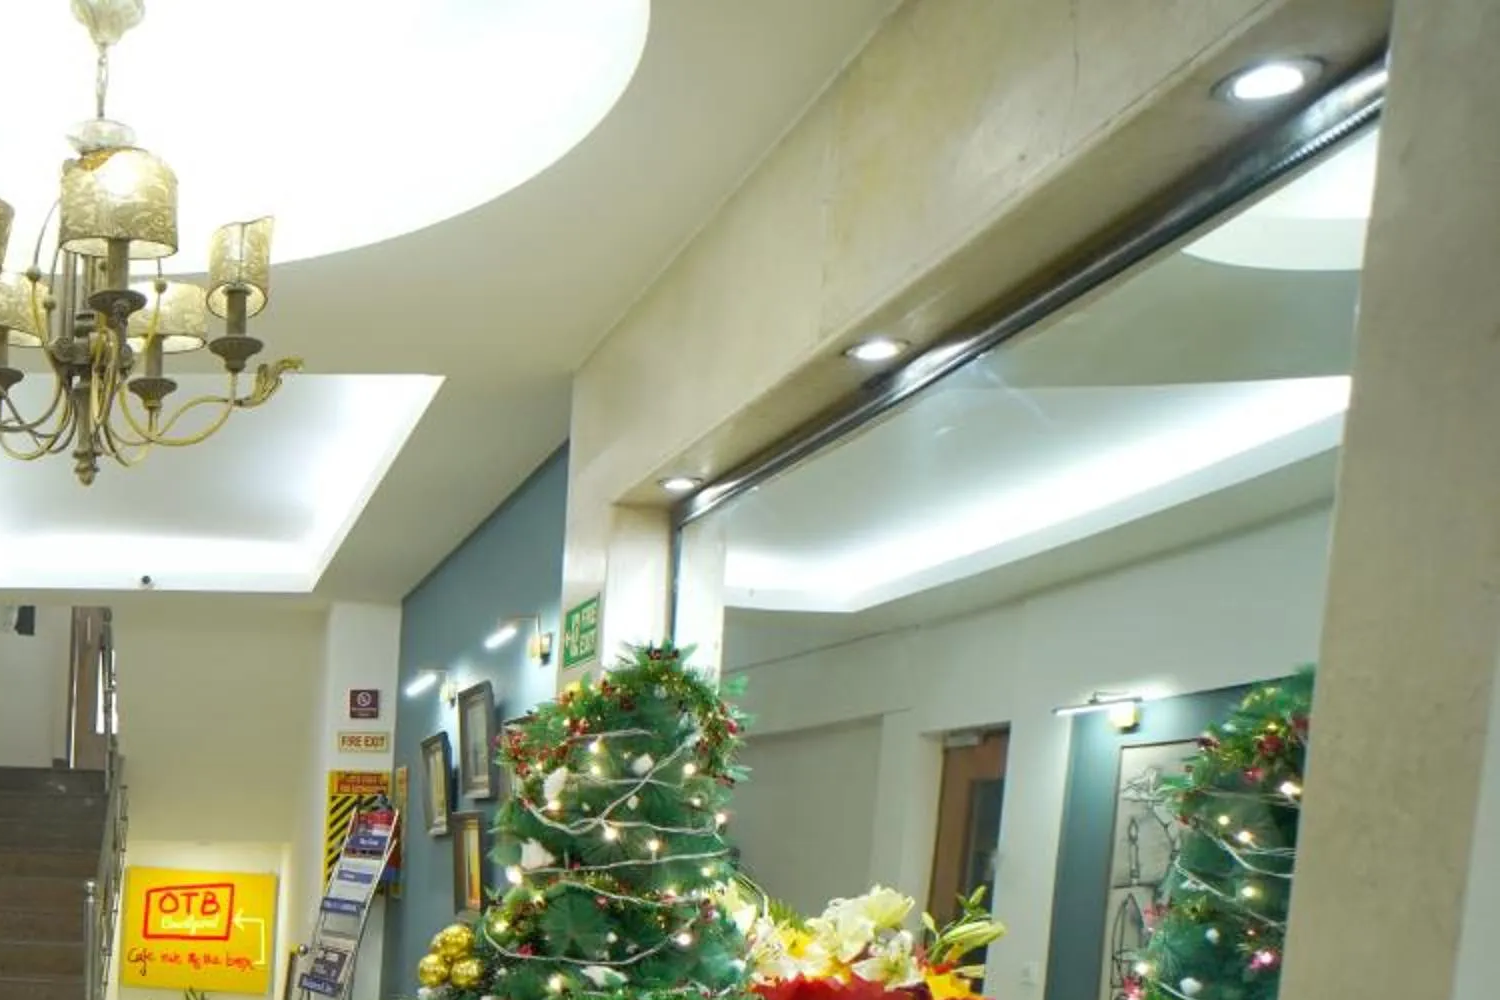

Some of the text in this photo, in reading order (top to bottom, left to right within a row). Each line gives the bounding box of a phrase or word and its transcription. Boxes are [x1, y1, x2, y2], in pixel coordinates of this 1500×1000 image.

[341, 735, 385, 747] FIRE EXIT
[159, 891, 221, 916] OTB
